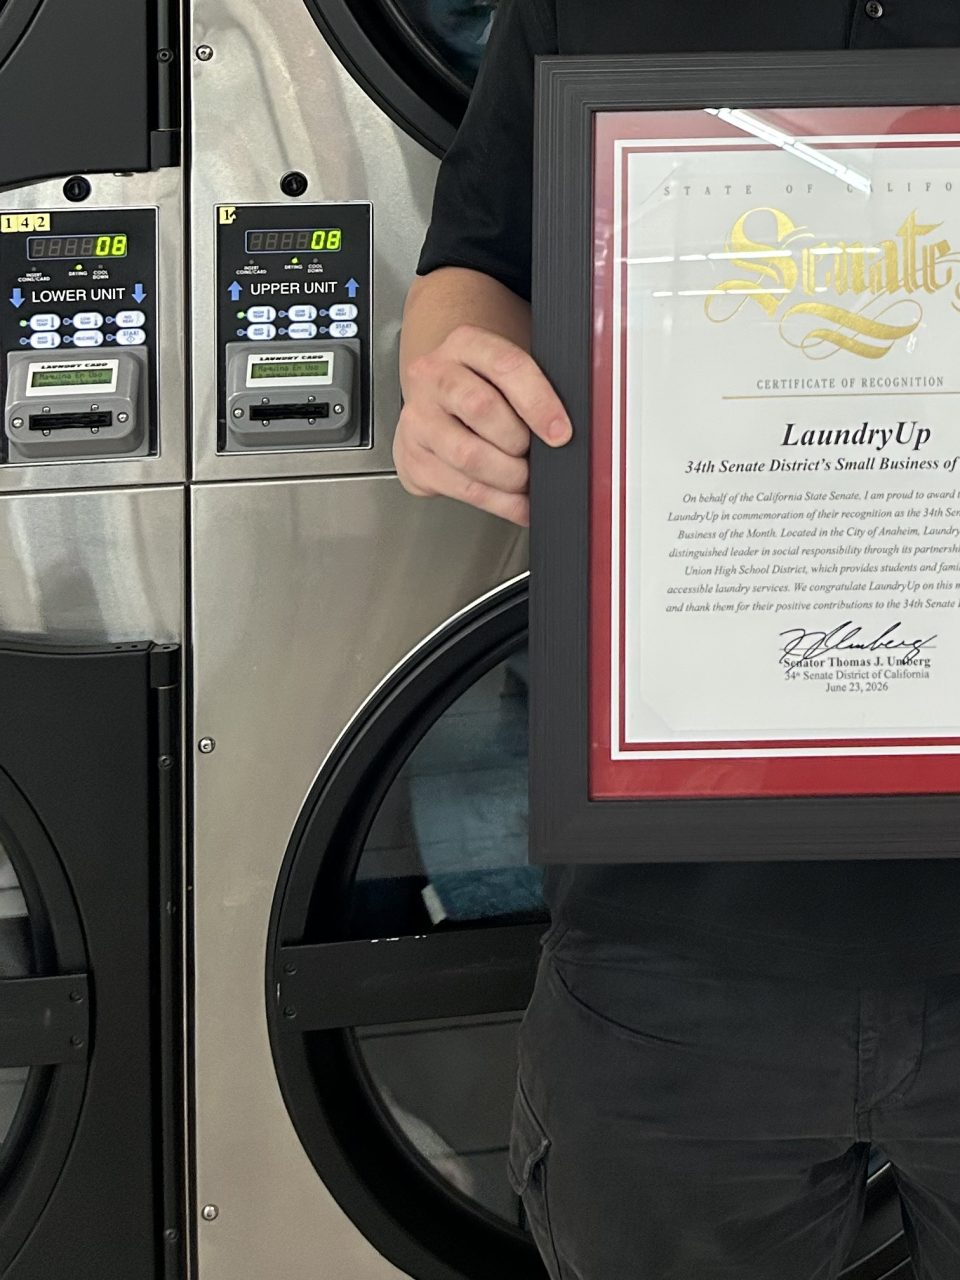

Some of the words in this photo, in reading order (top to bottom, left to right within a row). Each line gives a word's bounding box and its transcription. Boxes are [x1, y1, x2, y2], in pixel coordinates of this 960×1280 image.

[664, 184, 752, 196] STATE
[786, 184, 812, 194] OF
[96, 236, 126, 256] 08
[311, 230, 341, 250] 08
[32, 289, 87, 302] LOWER
[91, 288, 126, 300] UNIT
[250, 282, 300, 295] UPPER
[304, 282, 338, 294] UNIT
[756, 378, 836, 390] CERTIFICATE
[842, 378, 855, 388] OF
[862, 376, 944, 388] RECOGNITION
[780, 421, 930, 450] LaundryUp
[685, 460, 714, 473] 34th
[719, 460, 765, 472] Senate
[835, 457, 875, 470] Small
[879, 457, 939, 470] Business
[943, 456, 960, 472] of
[683, 494, 696, 503] On
[699, 493, 727, 504] behalf
[729, 493, 739, 504] of
[740, 493, 754, 501] the
[756, 492, 802, 503] California
[805, 492, 827, 500] State
[864, 491, 868, 499] I
[886, 490, 913, 501] proud
[927, 489, 955, 499] award
[668, 512, 719, 522] LaundryUp
[806, 510, 817, 520] of
[818, 509, 839, 518] their
[841, 510, 892, 520] recognition
[907, 508, 920, 517] the
[923, 508, 943, 517] 34th
[678, 530, 716, 538] Business
[719, 529, 730, 540] of
[730, 529, 744, 538] the
[746, 529, 775, 537] Month.
[781, 528, 817, 537] Located
[830, 527, 844, 536] the
[847, 527, 865, 538] City
[867, 527, 878, 537] of
[879, 526, 919, 536] Anaheim,
[669, 547, 728, 559] distinguished
[730, 547, 759, 556] leader
[772, 546, 799, 555] social
[802, 545, 862, 557] responsibility
[864, 545, 899, 556] through
[685, 566, 711, 575] Union
[714, 565, 736, 576] High
[739, 565, 769, 574] School
[772, 565, 807, 574] District,
[811, 564, 837, 572] which
[840, 563, 878, 575] provides
[880, 563, 916, 572] students
[920, 562, 938, 571] and
[667, 584, 713, 593] accessible
[716, 584, 750, 594] laundry
[795, 583, 807, 591] We
[809, 581, 866, 593] congratulate
[869, 581, 920, 592] LaundryUp
[937, 580, 952, 589] this
[666, 603, 684, 612] and
[686, 603, 709, 611] thank
[713, 602, 734, 611] them
[735, 602, 750, 612] for
[752, 602, 773, 610] their
[775, 603, 810, 612] positive
[813, 600, 872, 609] contributions
[887, 599, 900, 608] the
[903, 599, 922, 608] 34th
[925, 599, 955, 608] Senate
[784, 658, 824, 668] Senator
[828, 656, 870, 668] Thomas
[874, 656, 884, 666] J.
[804, 671, 833, 680] Senate
[836, 670, 869, 679] District
[872, 670, 882, 678] of
[884, 670, 930, 680] California
[826, 683, 846, 692] June
[849, 682, 863, 692] 23,
[866, 682, 888, 691] 2026
